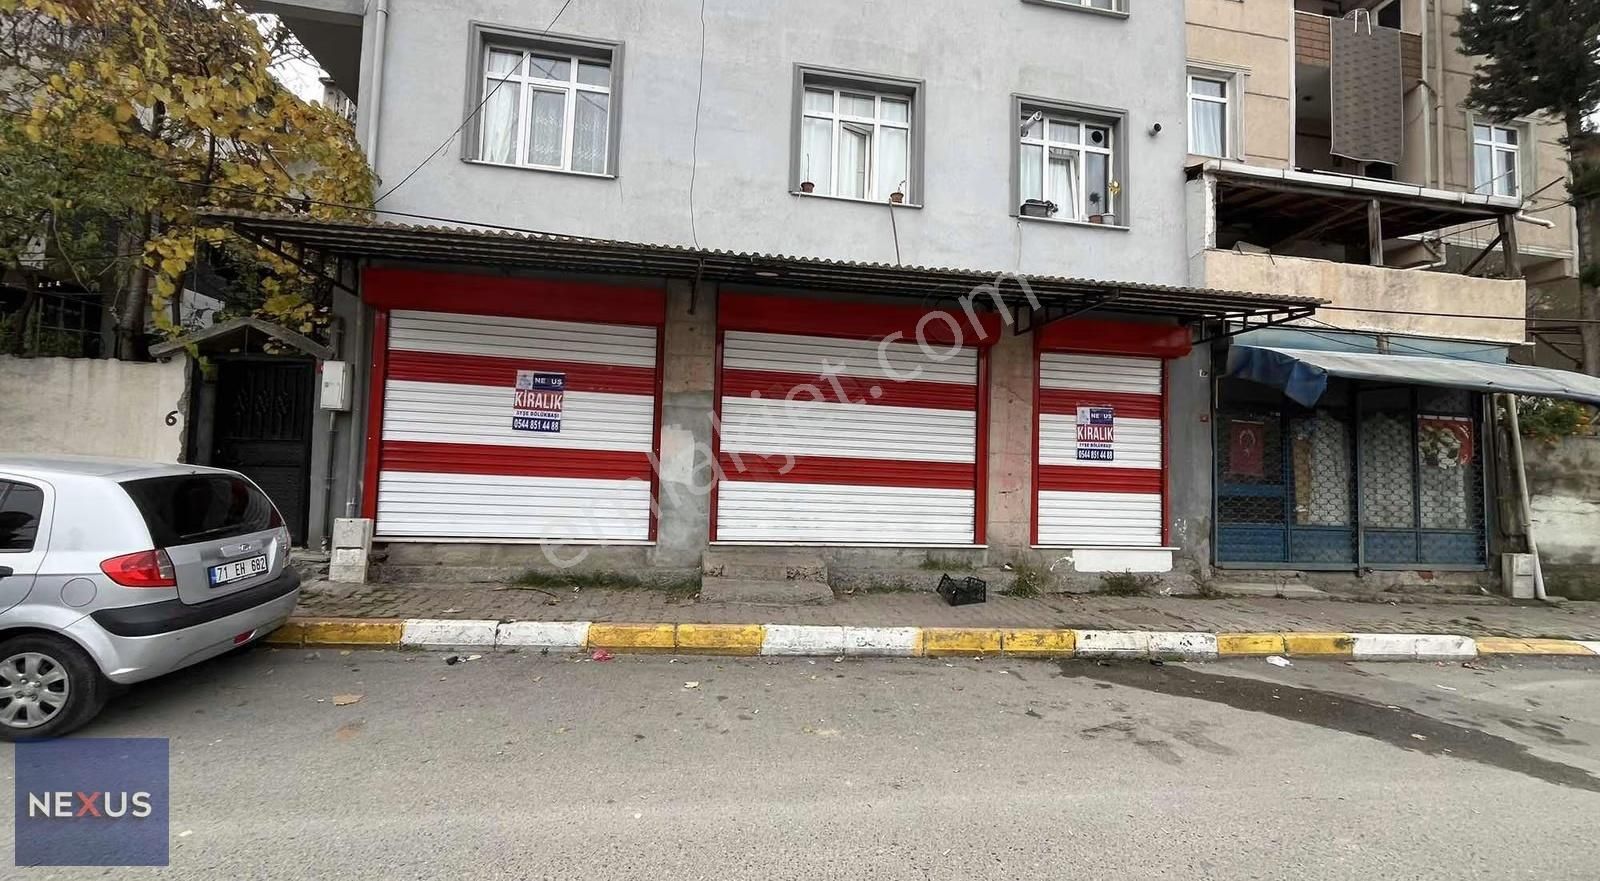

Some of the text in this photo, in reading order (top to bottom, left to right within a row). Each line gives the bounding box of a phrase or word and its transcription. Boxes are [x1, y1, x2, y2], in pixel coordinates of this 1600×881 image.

[515, 390, 562, 409] KİRALIK
[165, 410, 178, 426] 6
[542, 420, 550, 430] 44
[1077, 424, 1113, 440] KİRALIK
[217, 557, 266, 581] 71 EH 682
